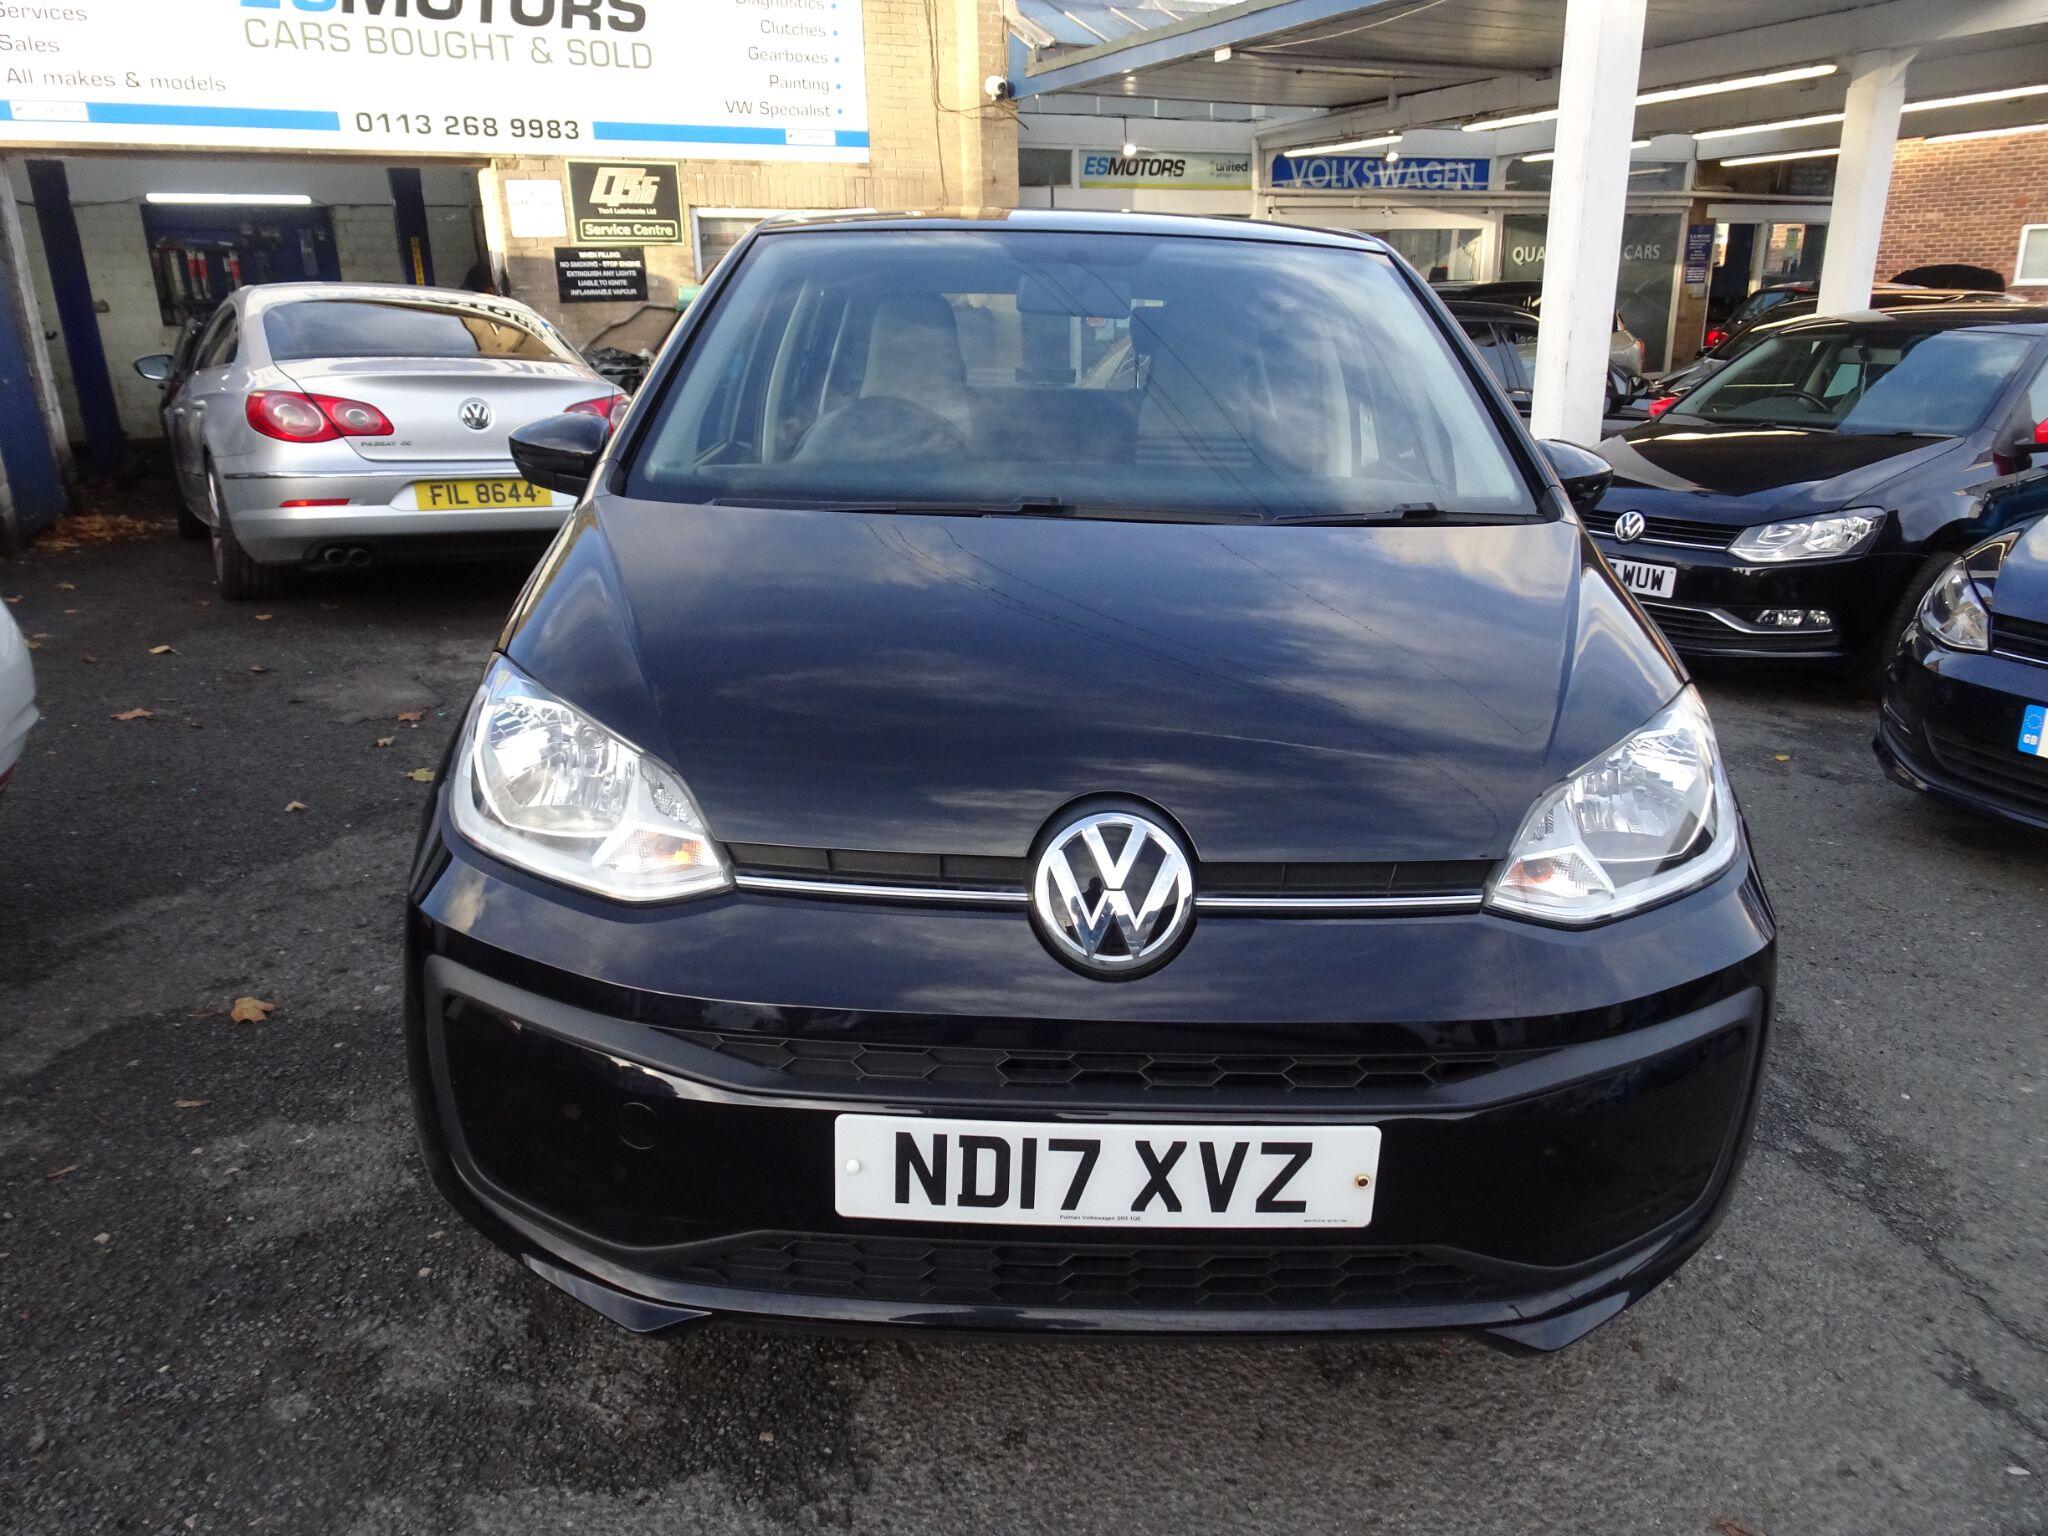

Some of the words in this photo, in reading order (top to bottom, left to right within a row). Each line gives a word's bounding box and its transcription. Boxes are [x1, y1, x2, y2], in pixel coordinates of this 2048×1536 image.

[239, 0, 647, 33] TORS
[760, 19, 827, 37] Clutches
[0, 34, 60, 53] Sales
[244, 18, 351, 52] CARS
[365, 26, 514, 62] BOUGHT
[531, 36, 553, 64] &
[567, 38, 652, 69] SOLD
[747, 46, 829, 64] Gearboxes
[7, 67, 34, 85] All
[43, 71, 116, 88] makes
[125, 72, 141, 88] &
[150, 75, 226, 92] models
[769, 74, 830, 95] Painting
[725, 100, 753, 114] VW
[759, 101, 832, 119] Specialist
[356, 112, 432, 134] 0113
[444, 115, 499, 137] 268
[510, 118, 580, 140] 9983
[1084, 156, 1186, 178] ESMOTORS
[1289, 158, 1476, 190] VOLKSWAGEN
[584, 223, 631, 236] Service
[633, 223, 673, 236] Centre
[1623, 244, 1661, 260] CARS
[570, 260, 598, 268] SMOKING
[602, 260, 618, 268] STOP
[615, 269, 637, 277] LIGHTS
[429, 484, 469, 505] FIL
[475, 482, 537, 503] 8644
[1623, 564, 1665, 591] WUW
[895, 1131, 1102, 1212] ND17
[1131, 1139, 1314, 1213] XVZ
